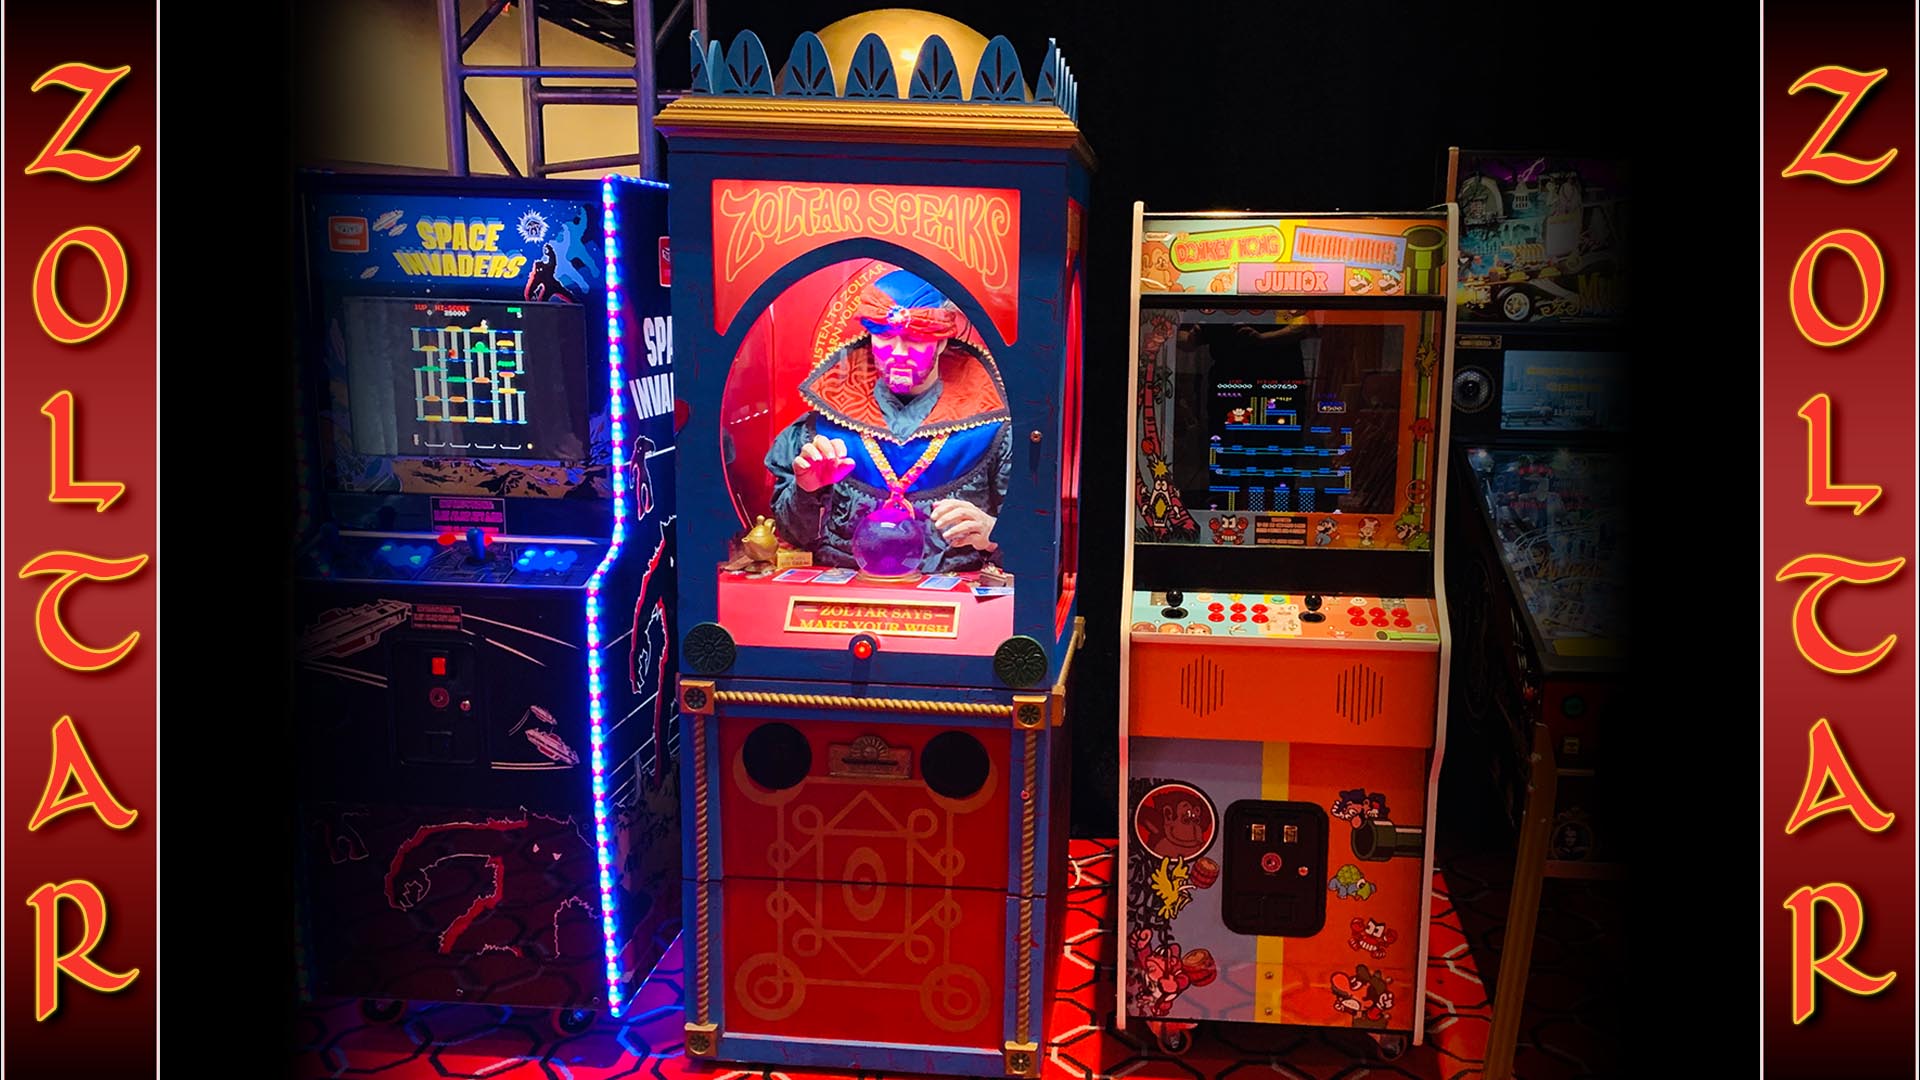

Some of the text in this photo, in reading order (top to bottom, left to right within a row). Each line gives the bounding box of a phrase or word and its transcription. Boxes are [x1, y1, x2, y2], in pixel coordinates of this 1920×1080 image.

[416, 217, 505, 252] SPACE
[720, 185, 1011, 290] ZOLTAR SPEAKS
[1175, 239, 1233, 265] DONKEY
[1237, 233, 1280, 259] KONG
[392, 249, 528, 279] INVADERS
[827, 301, 844, 319] TO
[840, 263, 887, 302] ZOLTAR
[1254, 270, 1329, 293] JUNIOR
[799, 618, 950, 633] MAKE YOUR WISH
[819, 604, 933, 620] ZOLTAR SAYS
